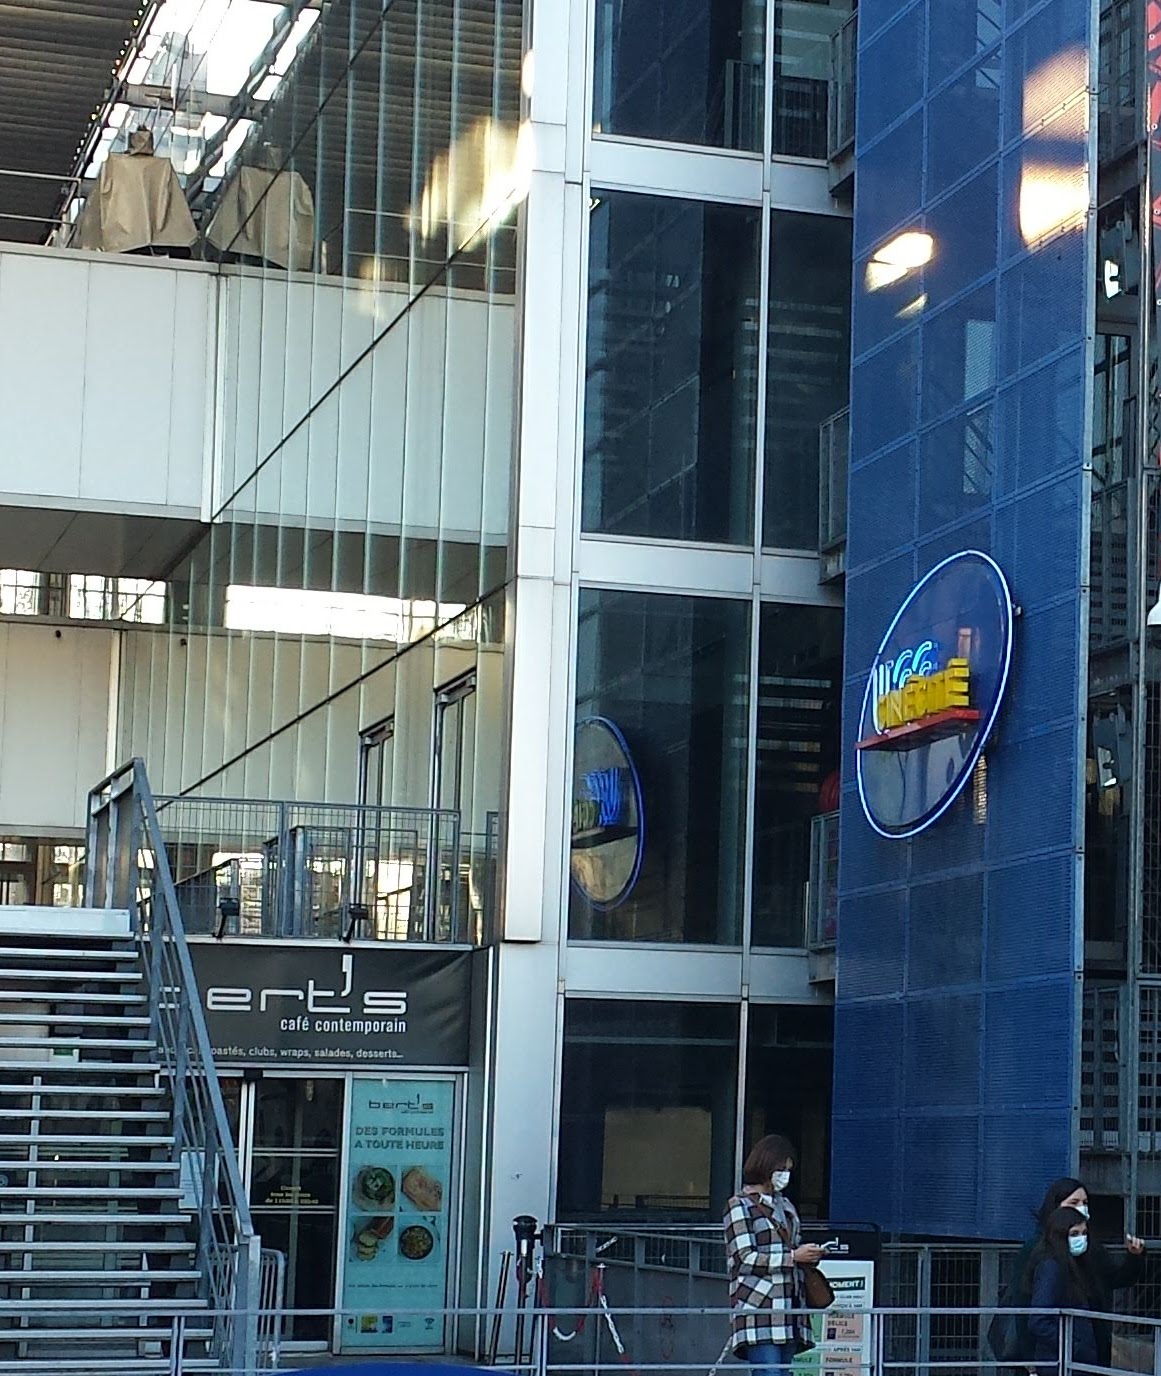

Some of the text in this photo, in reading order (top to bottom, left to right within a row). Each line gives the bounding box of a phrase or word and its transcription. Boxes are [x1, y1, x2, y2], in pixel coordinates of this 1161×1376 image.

[280, 1015, 407, 1035] café contemporain
[210, 1045, 246, 1058] oastés,
[314, 1048, 353, 1059] salades,
[355, 1126, 445, 1137] DES FORMULES
[365, 1139, 404, 1150] TOUTE
[405, 1140, 445, 1150] HEURE
